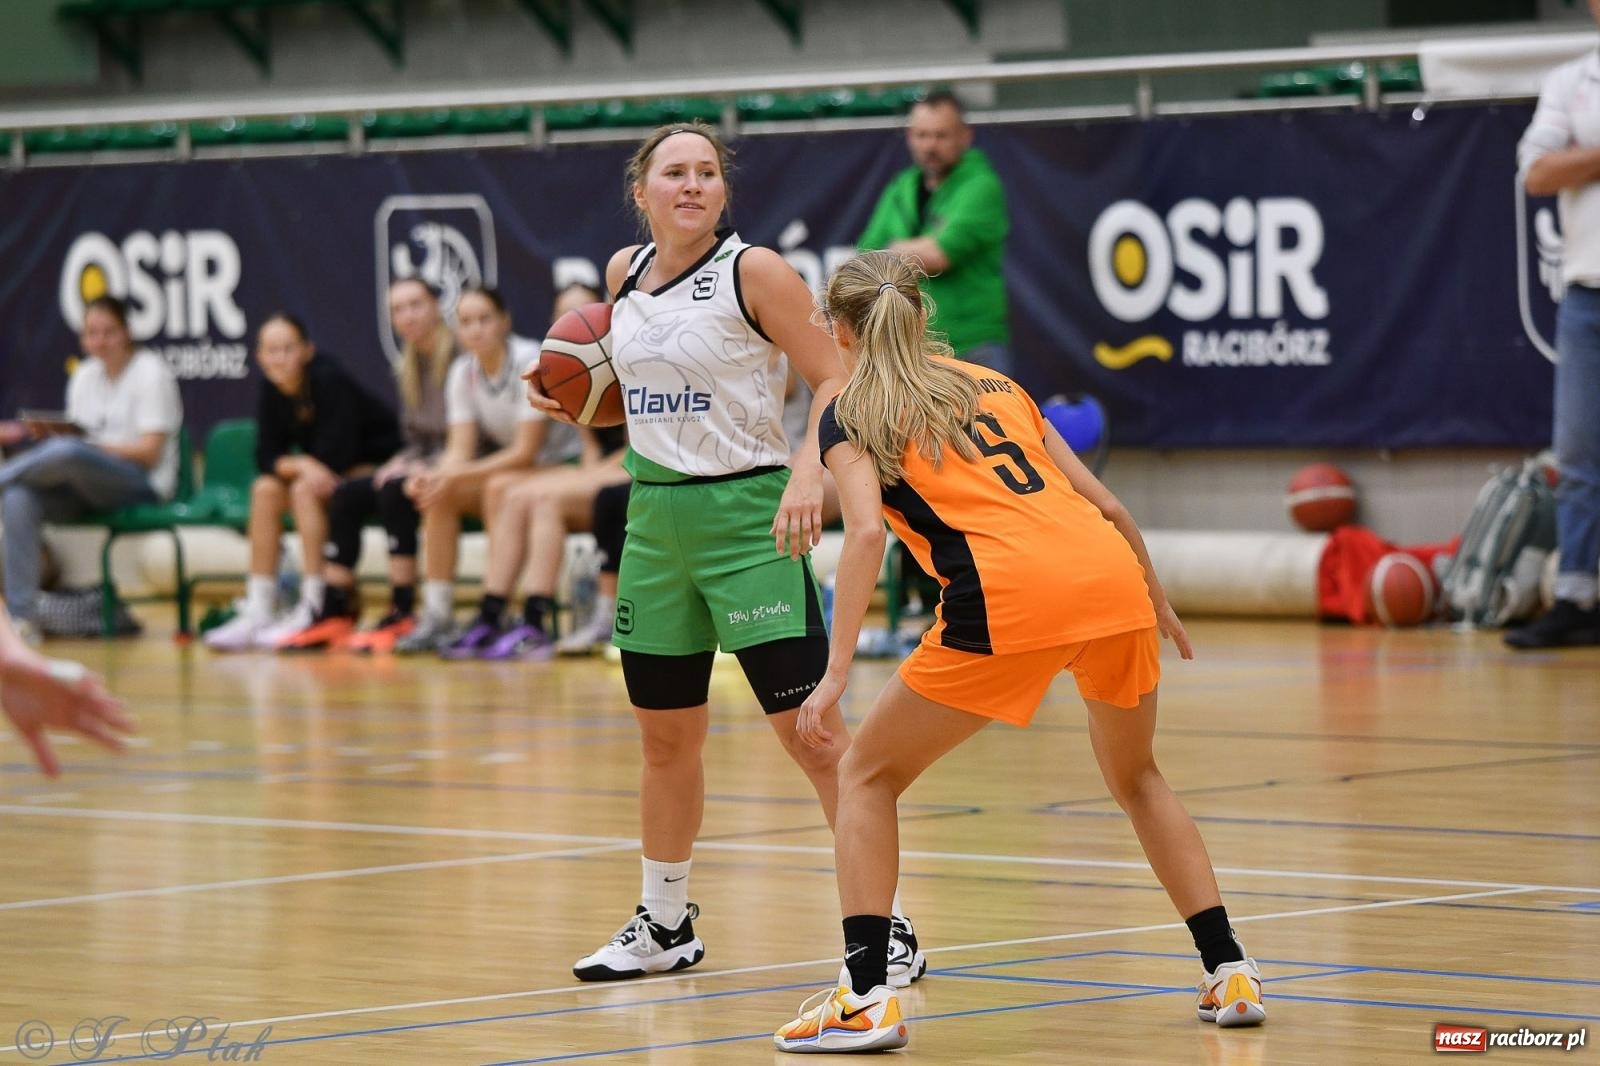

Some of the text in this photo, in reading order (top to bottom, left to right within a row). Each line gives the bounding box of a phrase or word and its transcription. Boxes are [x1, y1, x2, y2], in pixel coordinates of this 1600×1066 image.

[60, 230, 247, 343] OSiR
[1088, 197, 1330, 322] OSiR
[1183, 322, 1331, 367] RACIBÓRZ
[628, 385, 712, 415] Clavis
[964, 413, 1046, 495] 5
[773, 681, 818, 699] TARMAK
